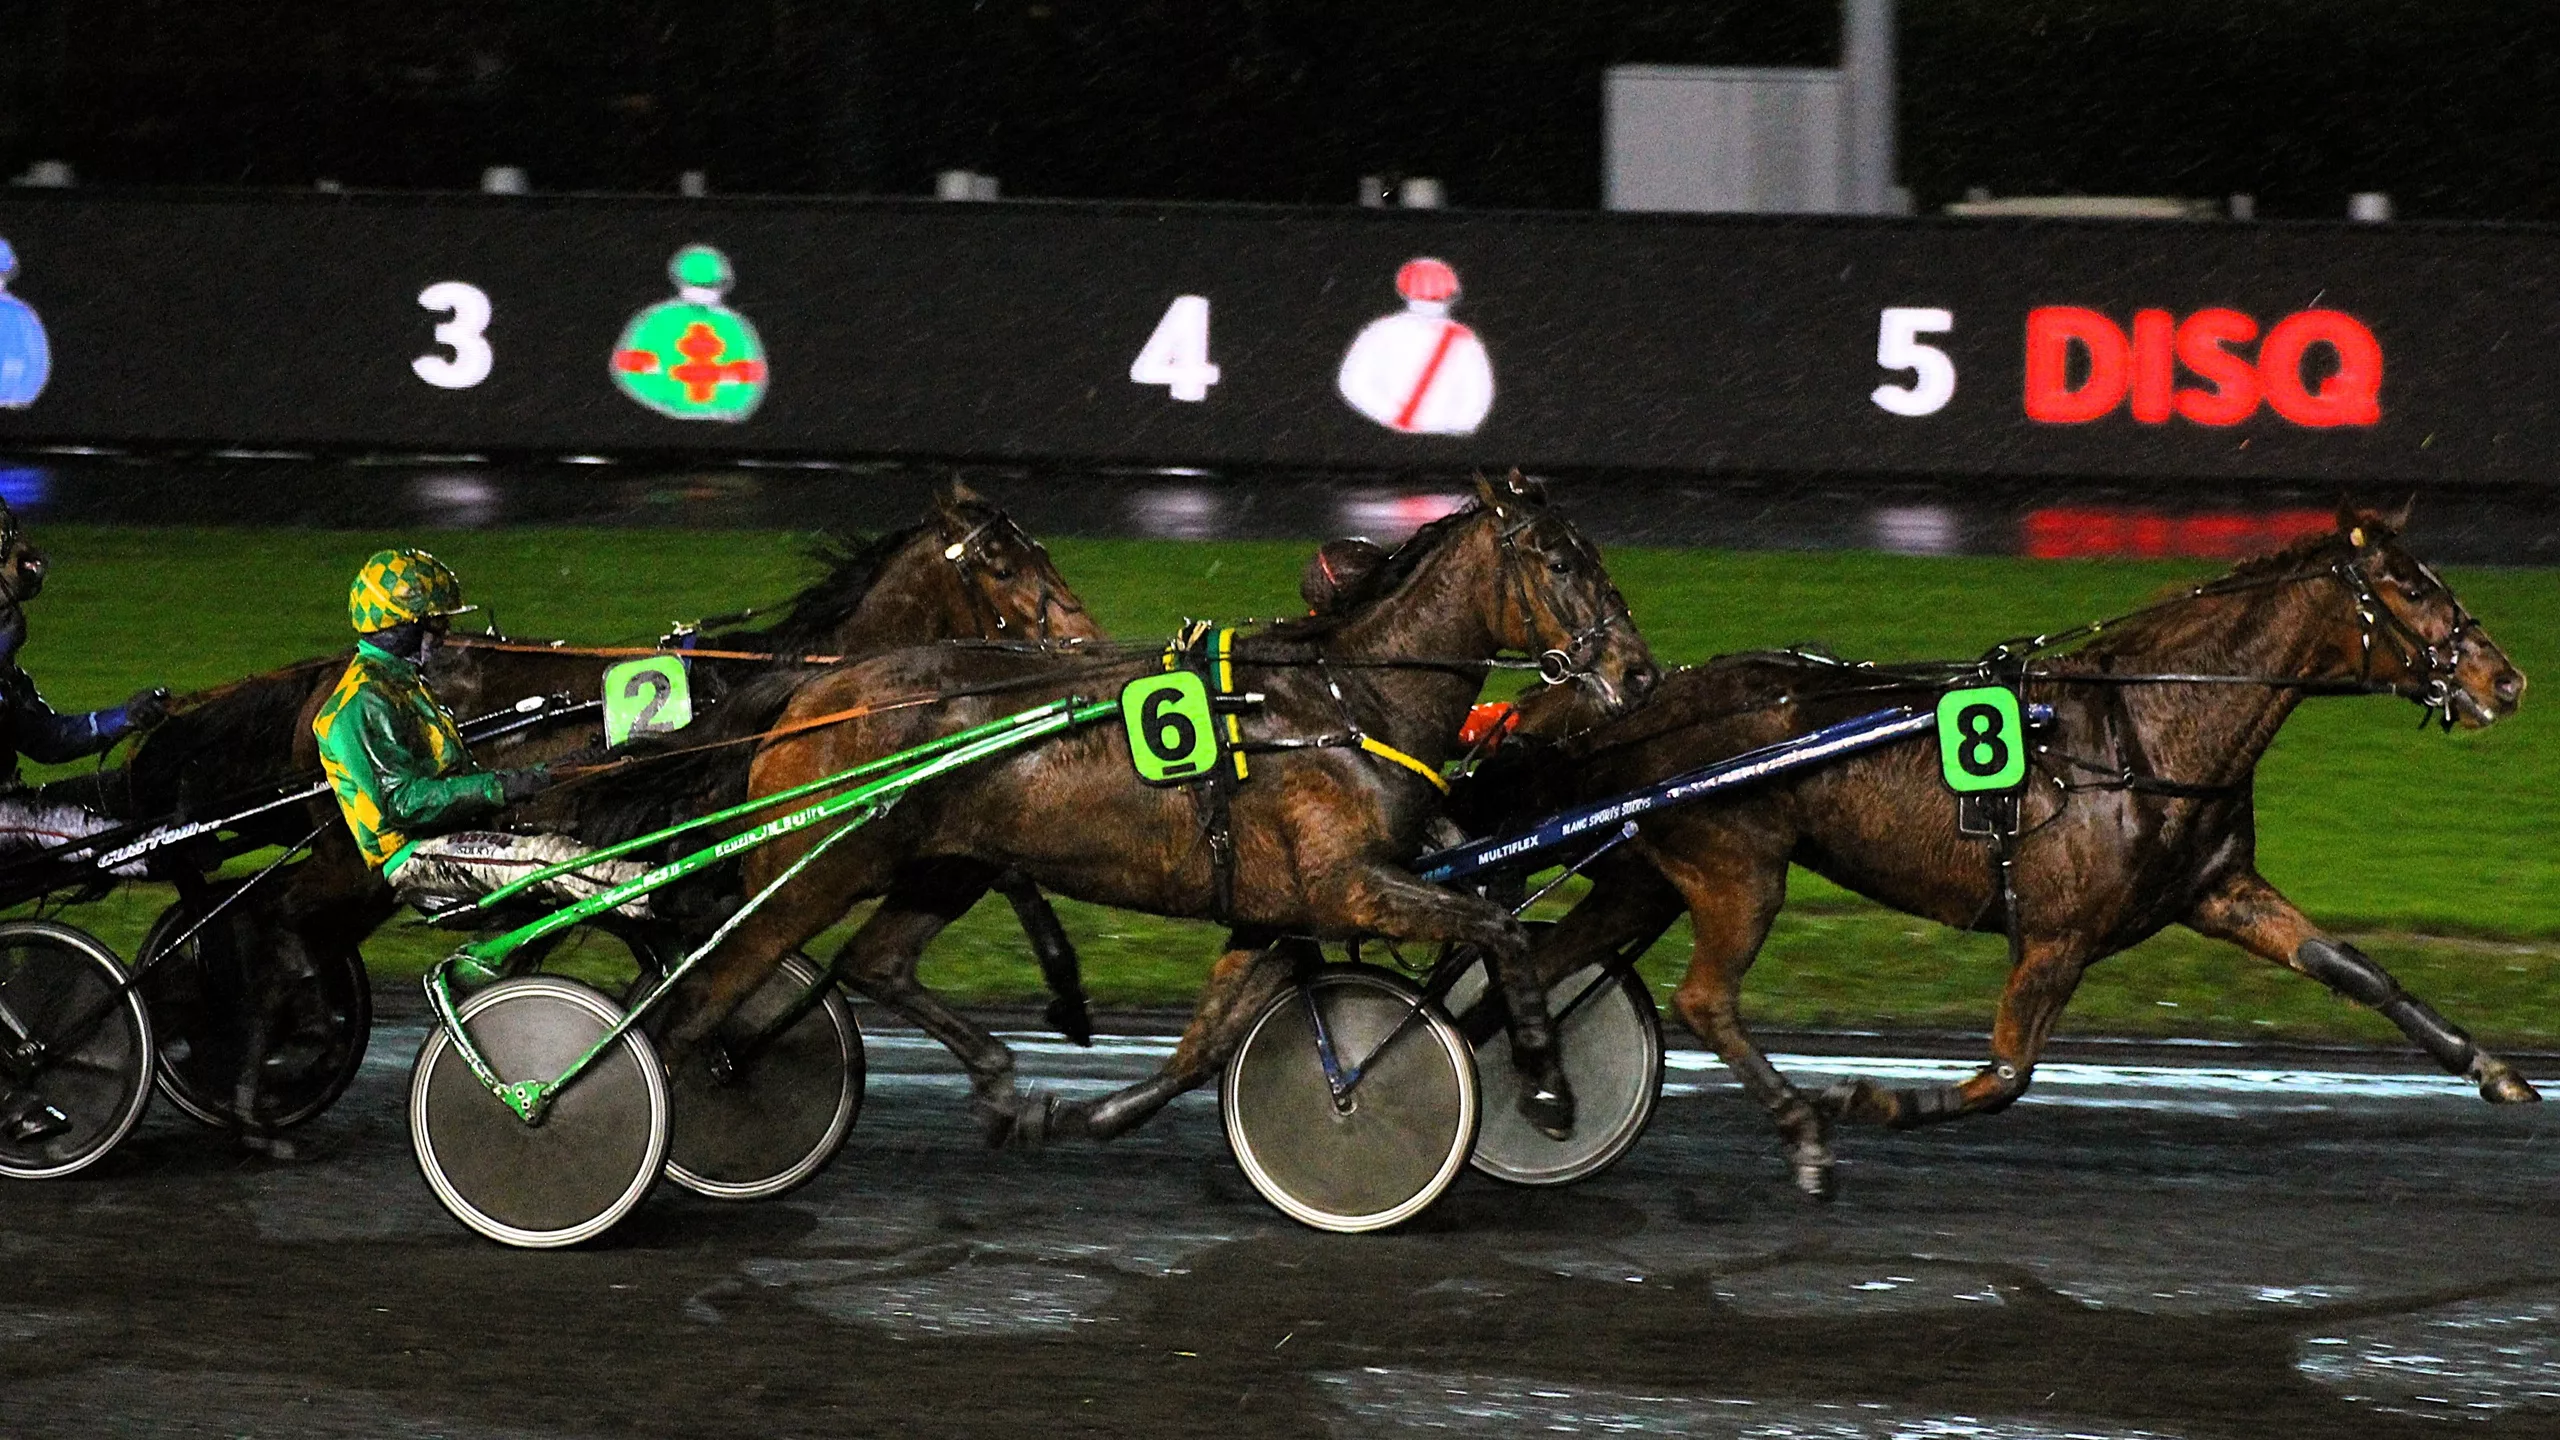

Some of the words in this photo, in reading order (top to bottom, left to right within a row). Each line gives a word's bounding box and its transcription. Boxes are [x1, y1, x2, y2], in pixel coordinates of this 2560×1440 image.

[411, 281, 493, 387] 3
[1129, 294, 1220, 402] 4
[1871, 307, 1956, 416] 5
[2024, 305, 2383, 427] DISQ
[624, 669, 671, 742] 2
[1141, 687, 1196, 762] 6
[1957, 703, 2009, 776] 8
[1478, 834, 1539, 865] MULTIFLEX
